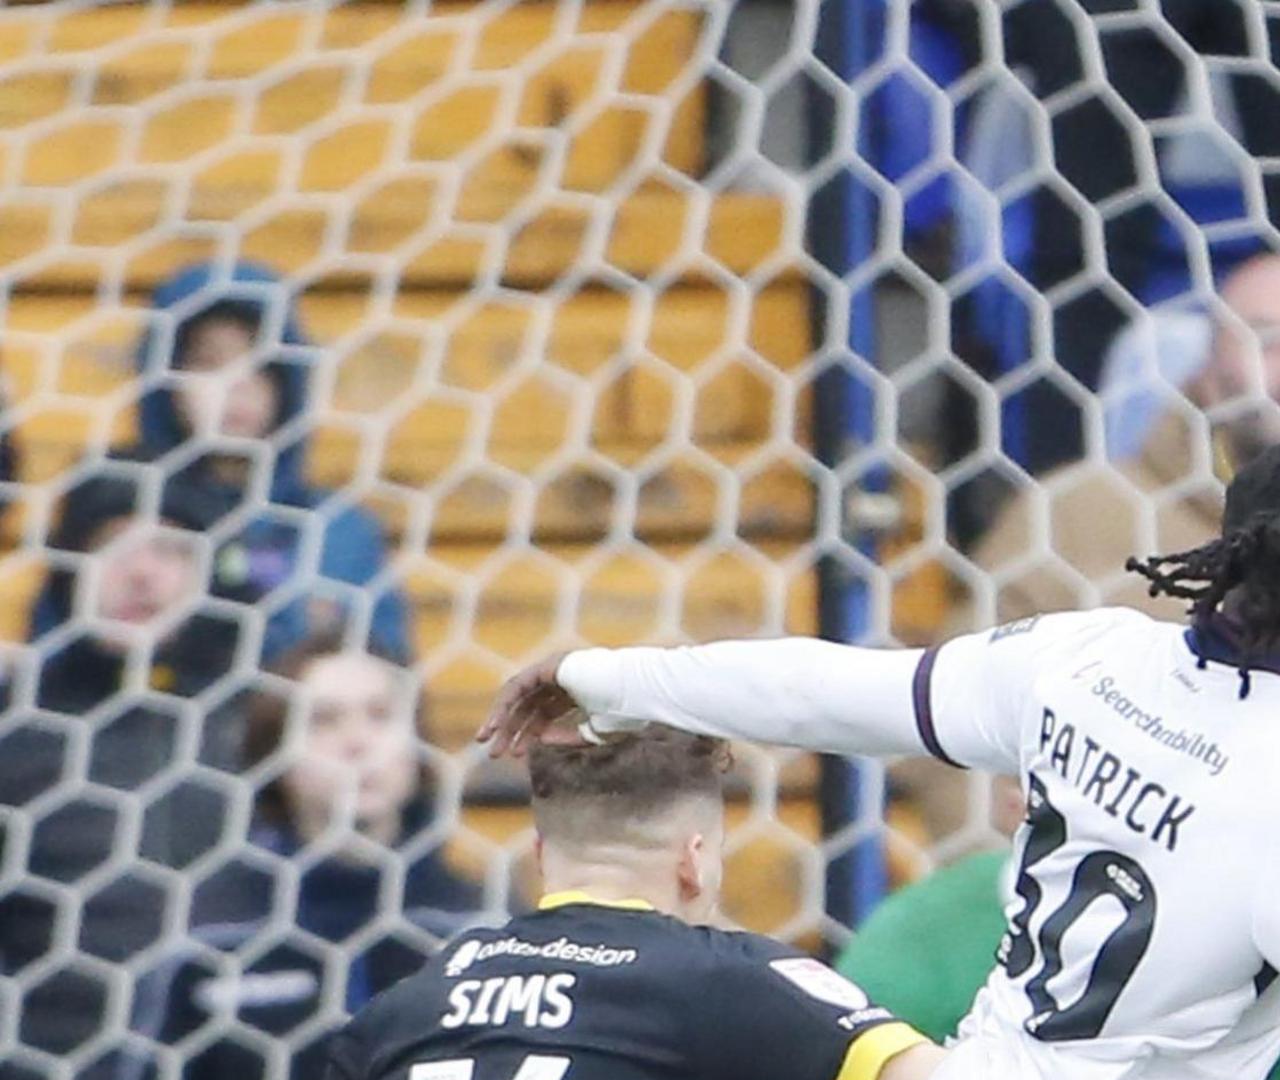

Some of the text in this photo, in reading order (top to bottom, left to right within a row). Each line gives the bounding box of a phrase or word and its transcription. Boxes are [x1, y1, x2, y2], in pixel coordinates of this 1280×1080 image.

[1091, 675, 1229, 777] Searchability
[1039, 706, 1196, 852] PATRICK
[441, 974, 576, 1029] SIMS
